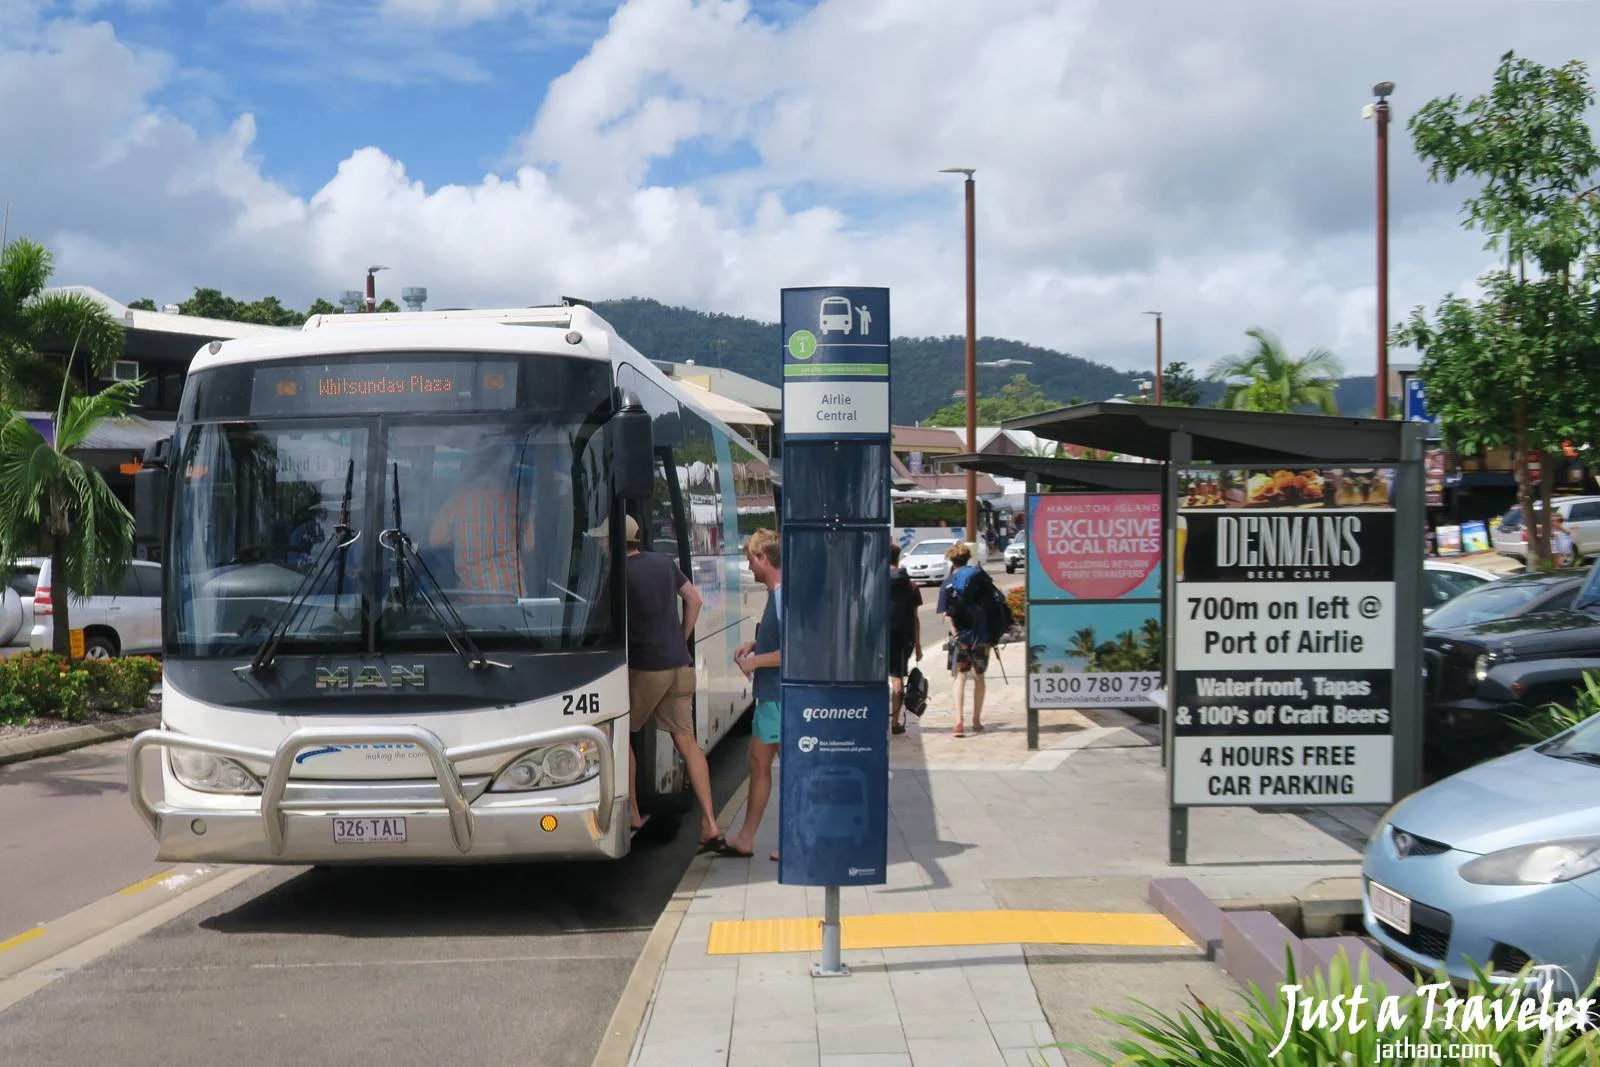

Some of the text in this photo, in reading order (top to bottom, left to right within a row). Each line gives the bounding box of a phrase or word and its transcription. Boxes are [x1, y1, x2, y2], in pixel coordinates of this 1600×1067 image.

[799, 340, 805, 353] 1
[319, 375, 453, 395] Whitsunday Plaza
[821, 394, 852, 405] Airlie
[816, 410, 857, 421] Central
[1047, 503, 1159, 513] HAMILTON ISLAND
[1047, 518, 1160, 539] EXCLUSIVE
[1047, 538, 1160, 554] LOCAL RATES
[1216, 515, 1362, 567] DENMANS
[1057, 559, 1149, 570] INCLUDING RETURN
[1061, 569, 1145, 579] FERRY TRANSFERS
[1247, 571, 1331, 579] BEER CAFE
[1188, 596, 1382, 620] 700m on left @
[1204, 630, 1364, 654] Port of Airlie
[315, 664, 425, 689] MAN
[1034, 675, 1161, 693] 1300 780 797
[1196, 676, 1371, 699] Waterfront, Tapas
[562, 693, 600, 715] 246
[803, 706, 869, 722] qconnect
[1175, 704, 1390, 725] & 100's of Craft Beers
[366, 752, 392, 761] making
[394, 750, 406, 758] the
[1200, 745, 1356, 766] 4 HOURS FREE
[1208, 774, 1354, 796] CAR PARKING
